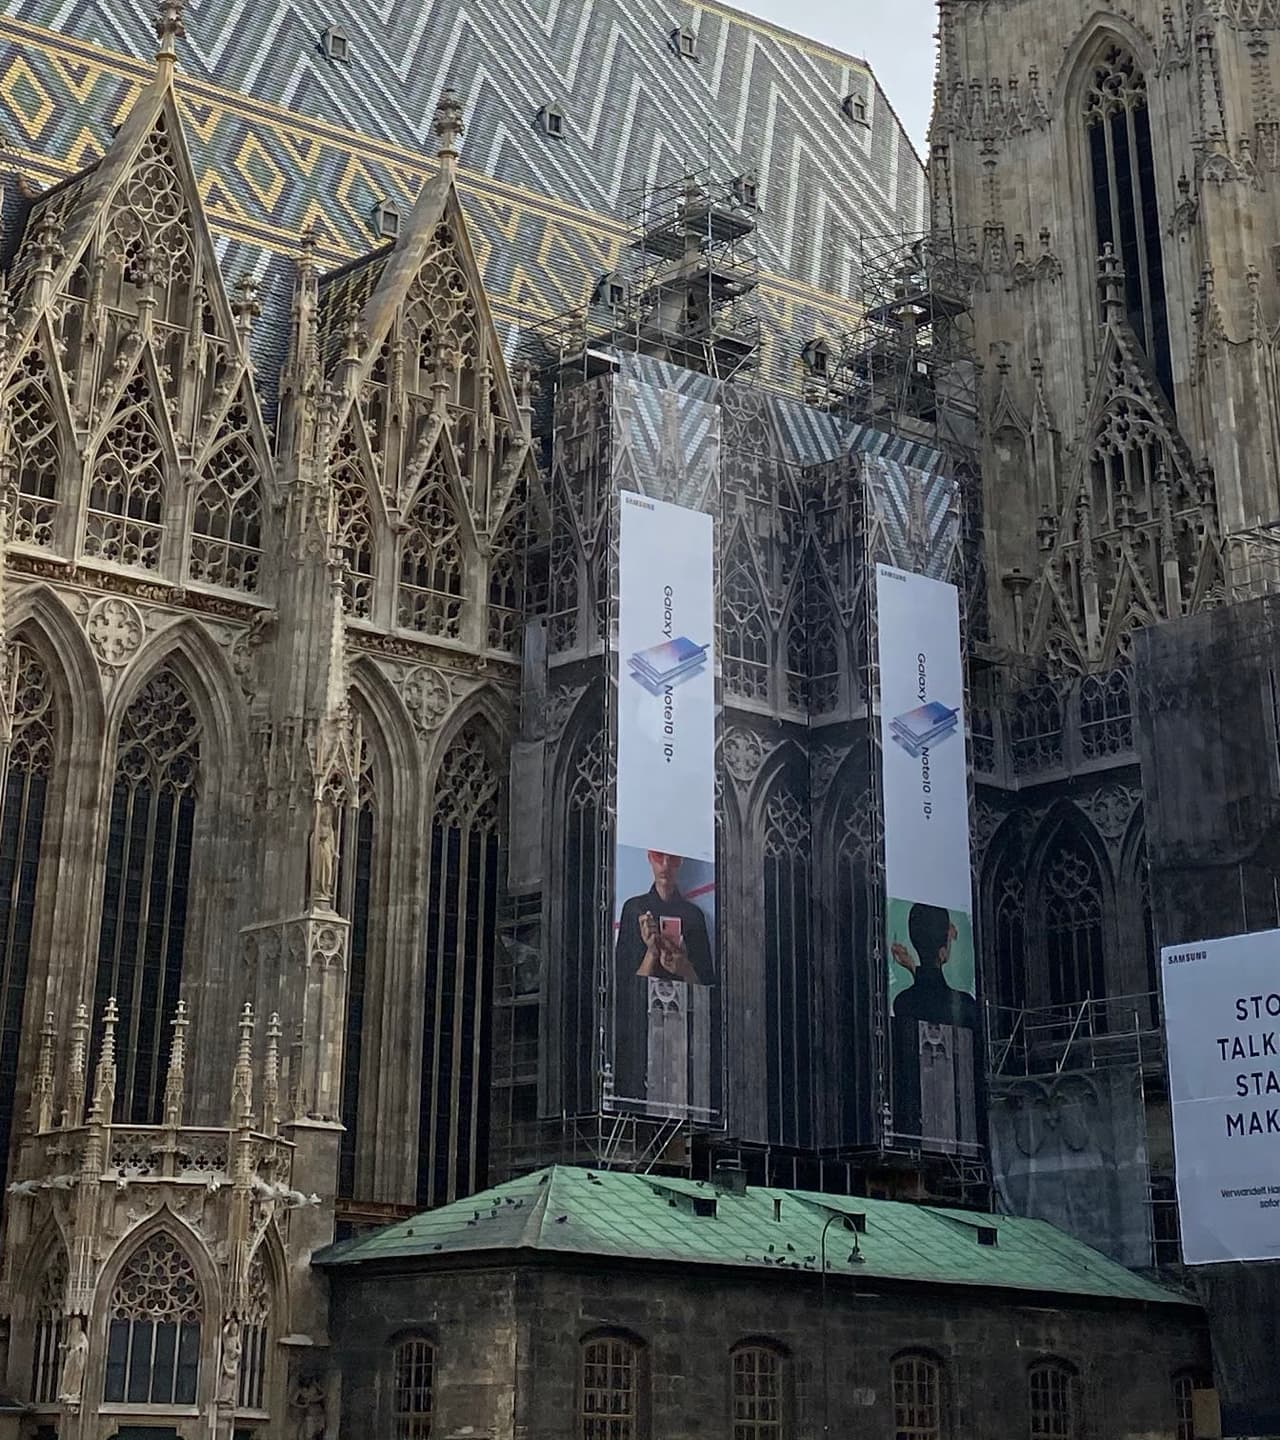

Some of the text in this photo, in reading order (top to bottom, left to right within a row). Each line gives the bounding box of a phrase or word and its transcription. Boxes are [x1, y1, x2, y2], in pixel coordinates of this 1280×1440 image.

[662, 585, 674, 763] Galaxy Note10 10+
[917, 653, 927, 703] Galaxy
[921, 746, 932, 793] Note10
[1168, 951, 1207, 965] SAMSUNG
[1220, 1186, 1267, 1199] Verwandelt
